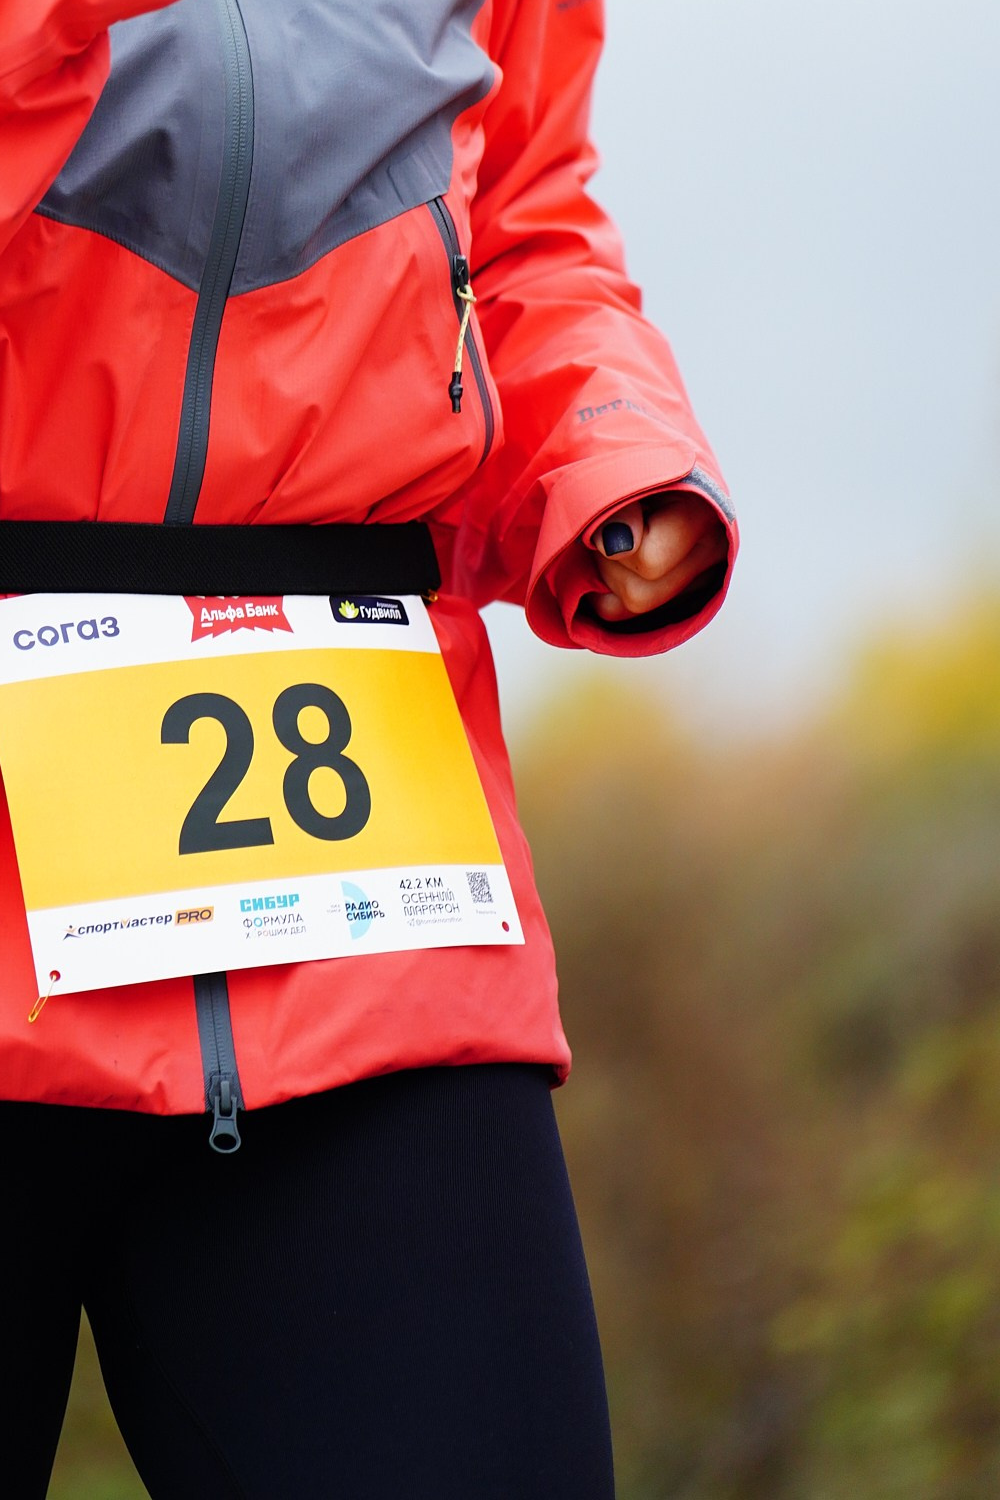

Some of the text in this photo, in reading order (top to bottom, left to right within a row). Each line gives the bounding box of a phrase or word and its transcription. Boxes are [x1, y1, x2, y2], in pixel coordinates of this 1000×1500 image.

[200, 602, 279, 623] Альфа Банк
[160, 682, 372, 856] 28
[400, 878, 422, 889] 42.2
[240, 893, 300, 912] СИБУР
[401, 888, 455, 904] ОСЕННИЙ
[345, 900, 379, 911] РАДИО
[403, 903, 460, 916] МАРАФОН
[177, 909, 212, 924] PRO
[243, 913, 304, 928] ФОРМУЛА
[346, 910, 385, 921] СИБИРЬ
[245, 928, 288, 939] ХРОШИХ
